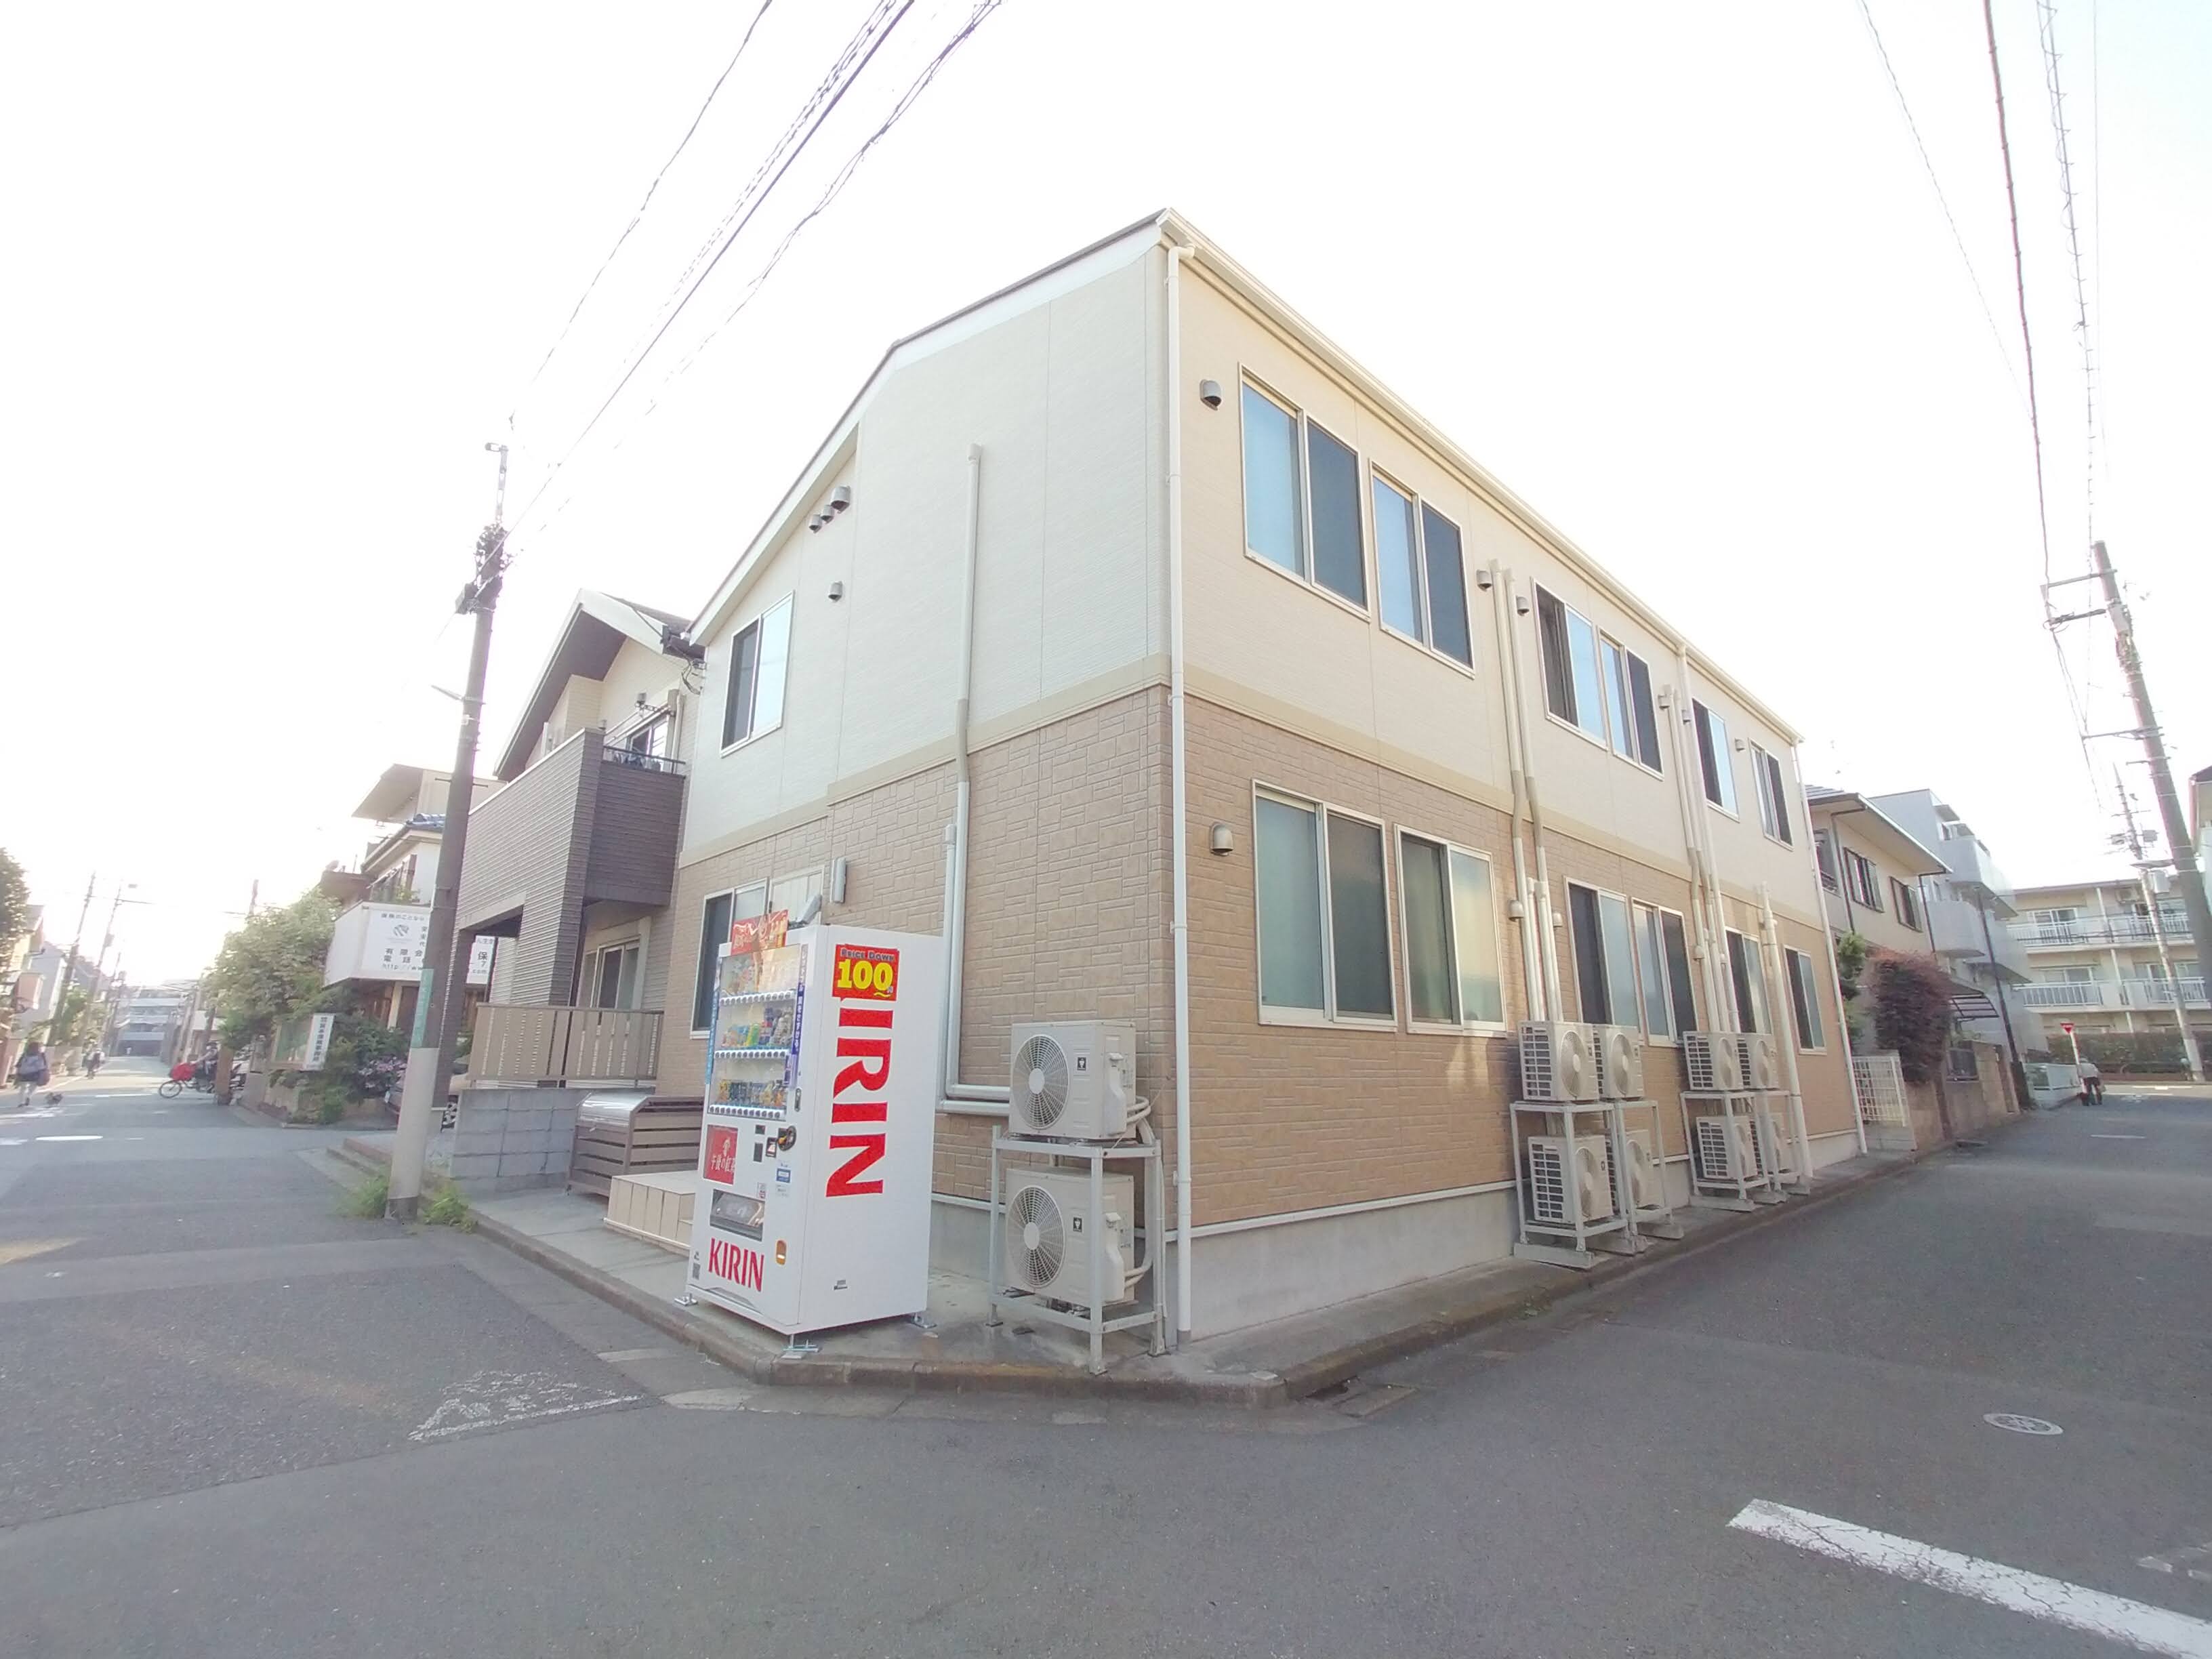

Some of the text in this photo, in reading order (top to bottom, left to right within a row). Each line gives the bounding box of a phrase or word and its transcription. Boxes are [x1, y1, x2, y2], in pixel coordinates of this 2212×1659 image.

[868, 951, 895, 961] DOWN
[825, 1007, 893, 1197] IRIN
[708, 1237, 764, 1292] KIRIN
